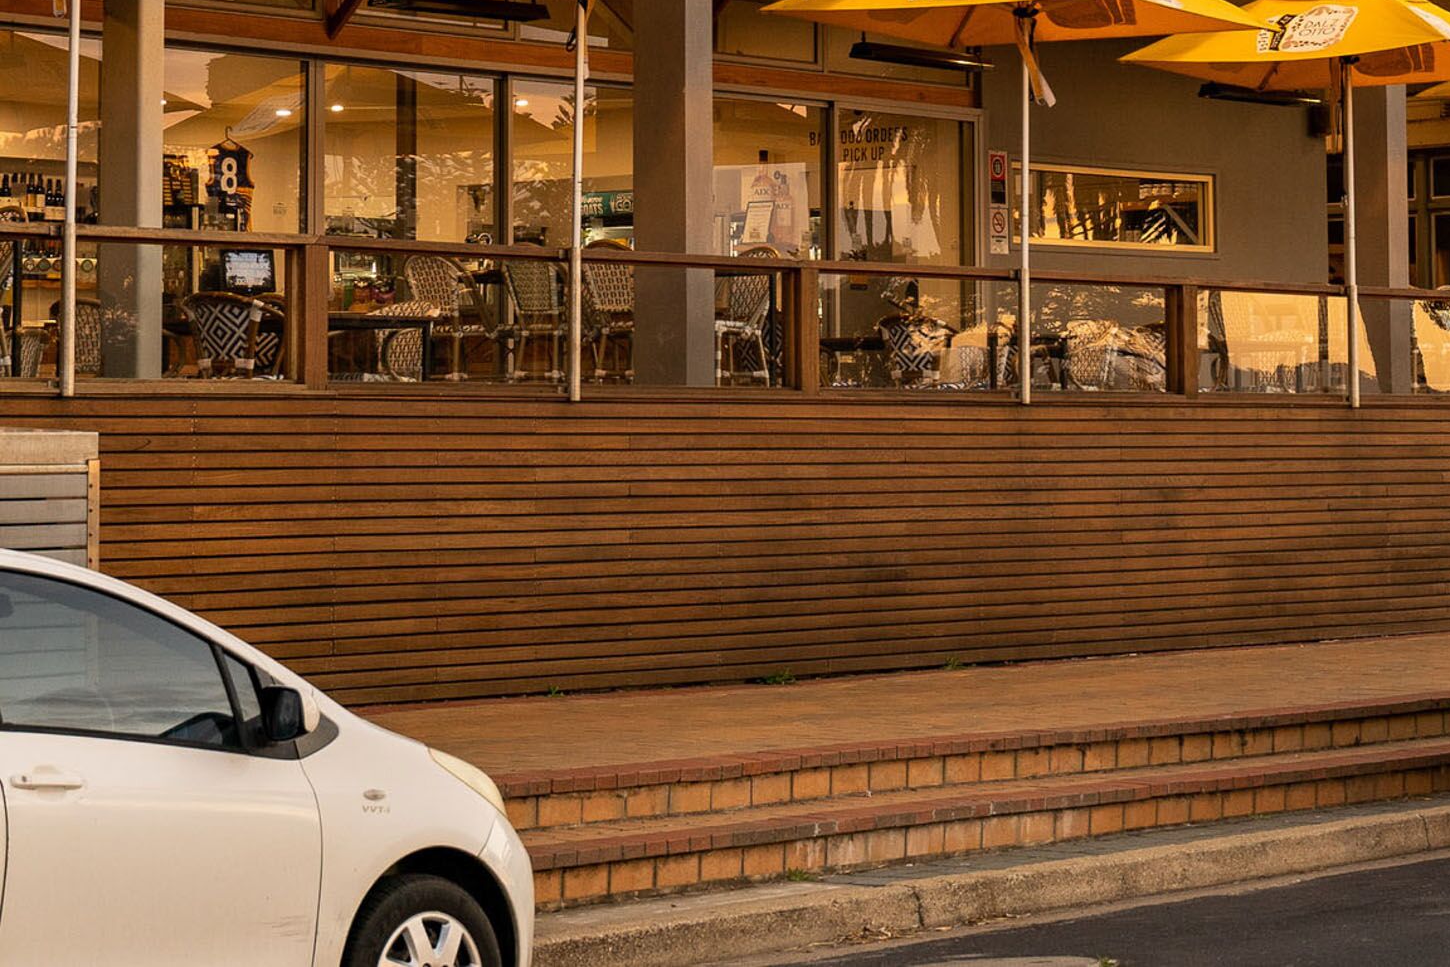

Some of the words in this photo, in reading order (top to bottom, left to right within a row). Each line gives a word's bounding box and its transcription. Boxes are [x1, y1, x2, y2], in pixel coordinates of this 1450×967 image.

[841, 130, 862, 144] OOD
[843, 147, 867, 162] PICK
[871, 146, 885, 160] UP
[221, 157, 238, 195] 8
